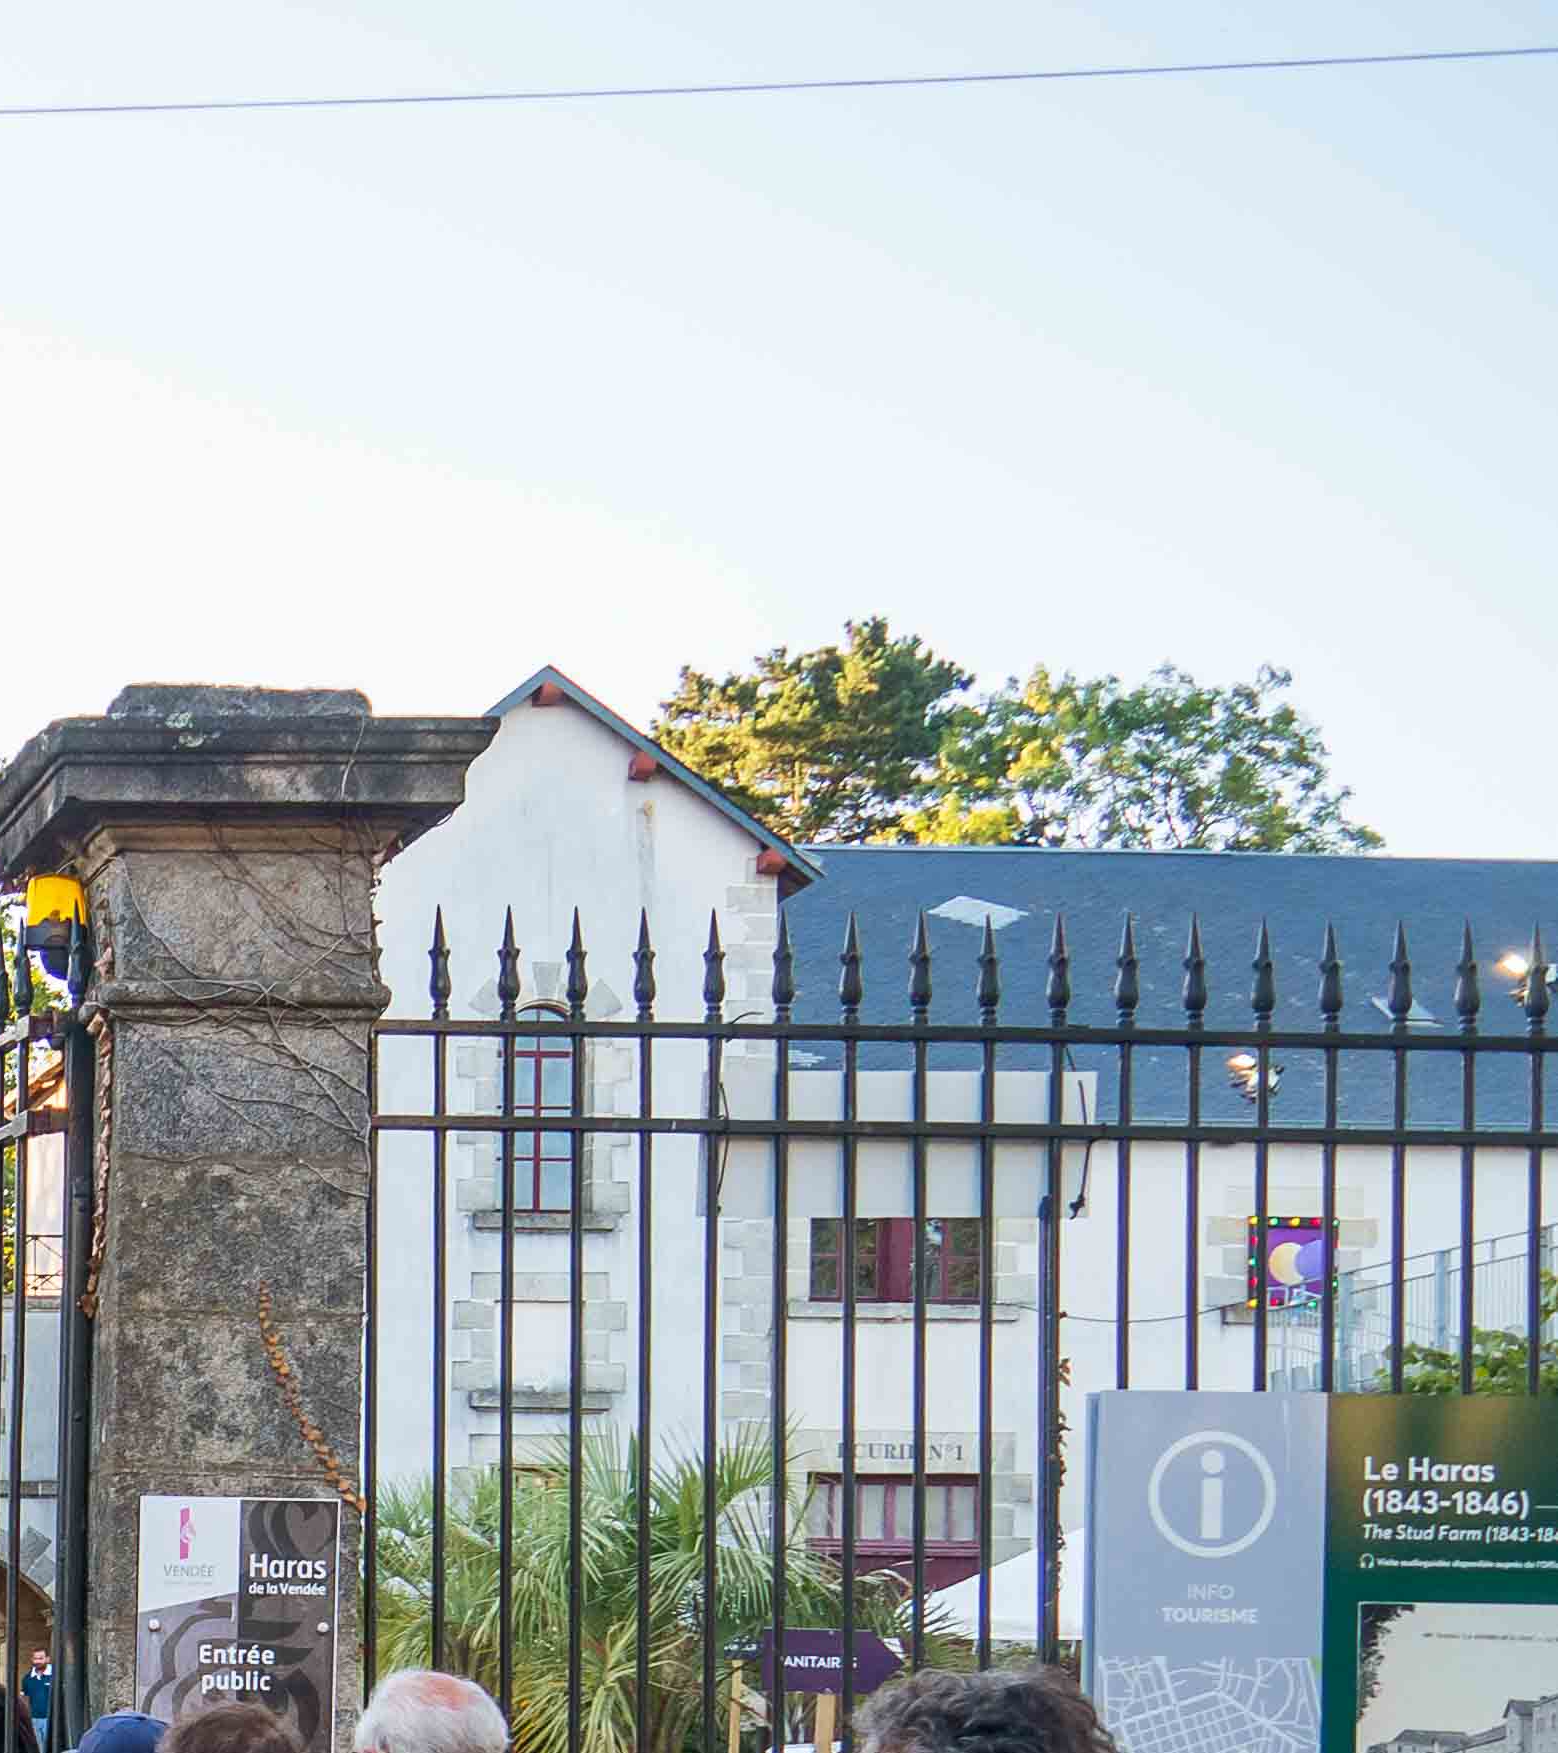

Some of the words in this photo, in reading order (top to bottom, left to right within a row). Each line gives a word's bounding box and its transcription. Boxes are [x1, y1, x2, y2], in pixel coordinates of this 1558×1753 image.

[1364, 1456, 1400, 1482] Le
[1408, 1456, 1496, 1483] Haras
[1362, 1488, 1530, 1520] (1843-1846)
[1363, 1524, 1394, 1541] The
[1396, 1524, 1436, 1541] Stud
[1438, 1525, 1483, 1542] Farm
[163, 1562, 216, 1577] VENDÉE
[249, 1553, 327, 1580] Haras
[248, 1583, 265, 1595] de
[266, 1582, 279, 1595] la
[280, 1582, 327, 1596] Vendée
[1187, 1583, 1236, 1601] INFO
[1160, 1607, 1259, 1625] TOURISME
[199, 1644, 276, 1665] Entrée
[201, 1671, 272, 1694] public
